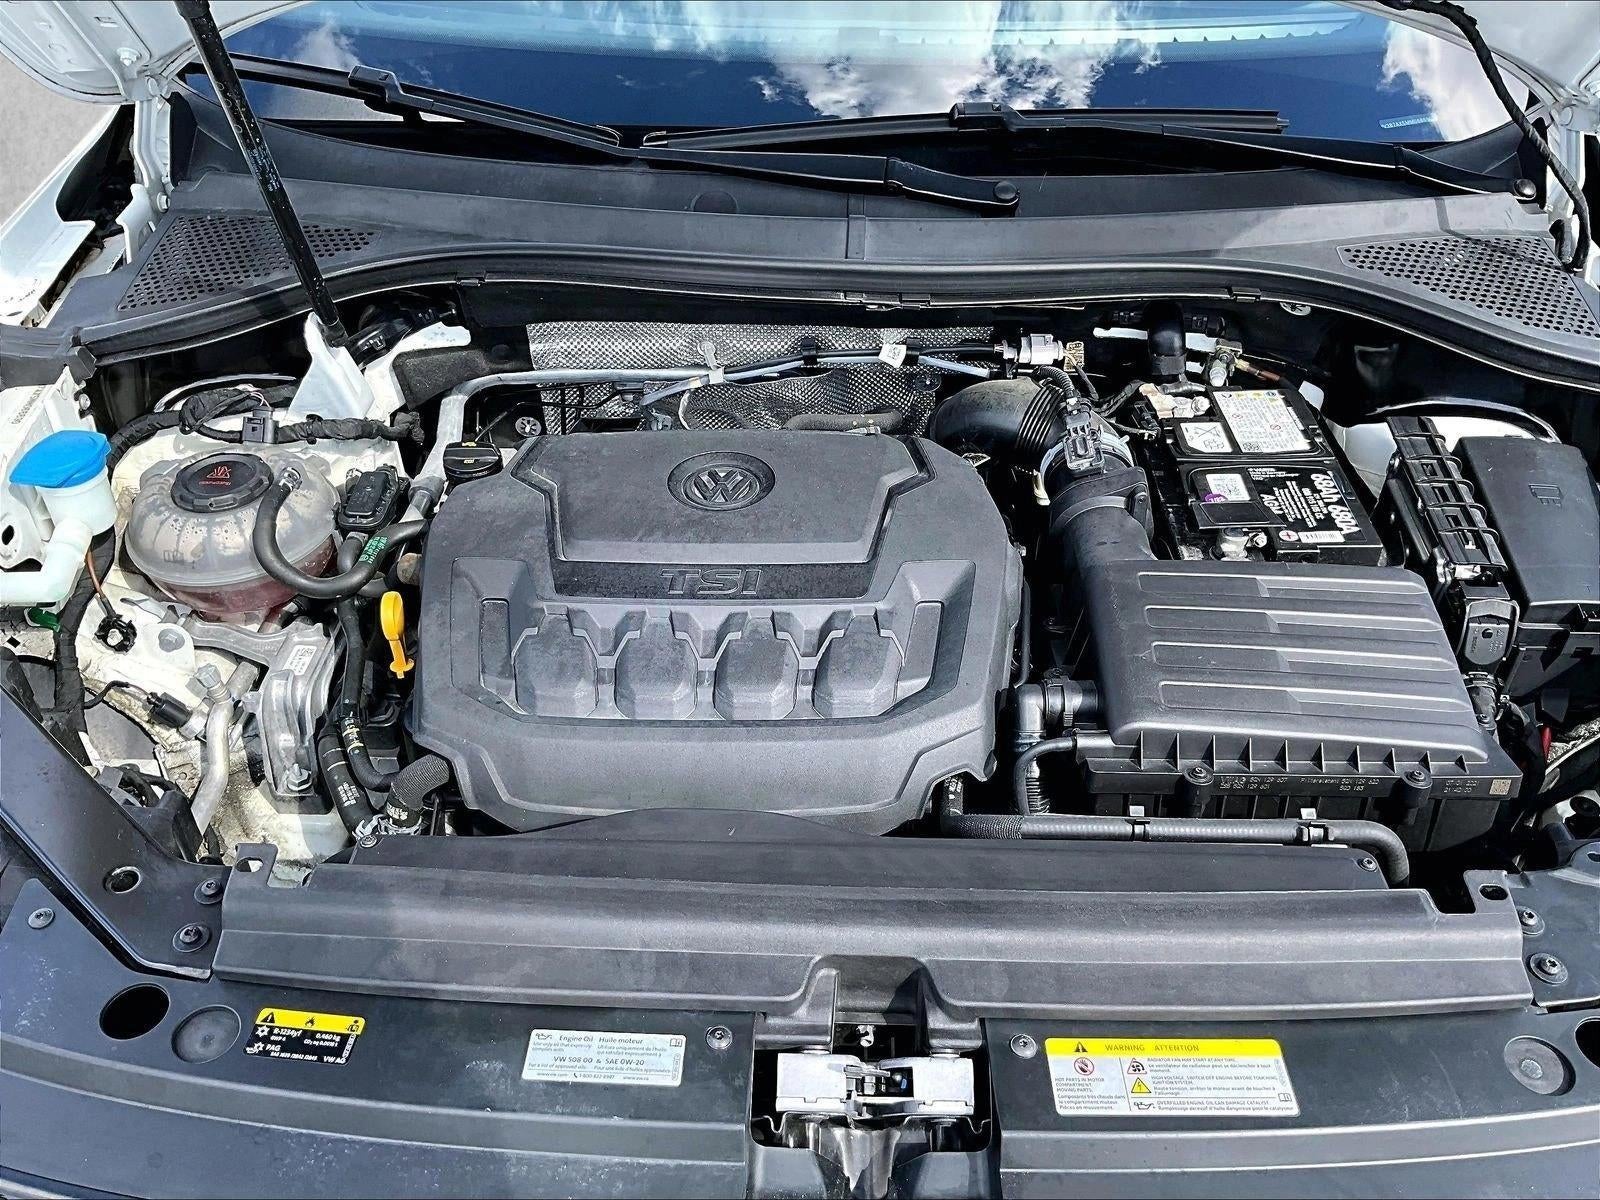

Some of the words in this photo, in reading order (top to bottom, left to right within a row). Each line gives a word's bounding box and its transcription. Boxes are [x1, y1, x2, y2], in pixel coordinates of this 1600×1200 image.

[1260, 494, 1284, 515] AGM
[1310, 473, 1342, 503] 68Ah
[1327, 504, 1361, 535] 680A
[660, 568, 762, 595] TSI
[559, 1035, 583, 1043] Engine
[583, 1035, 593, 1043] Oil
[1104, 1044, 1145, 1052] WARNING
[1154, 1044, 1200, 1052] ATTENTION
